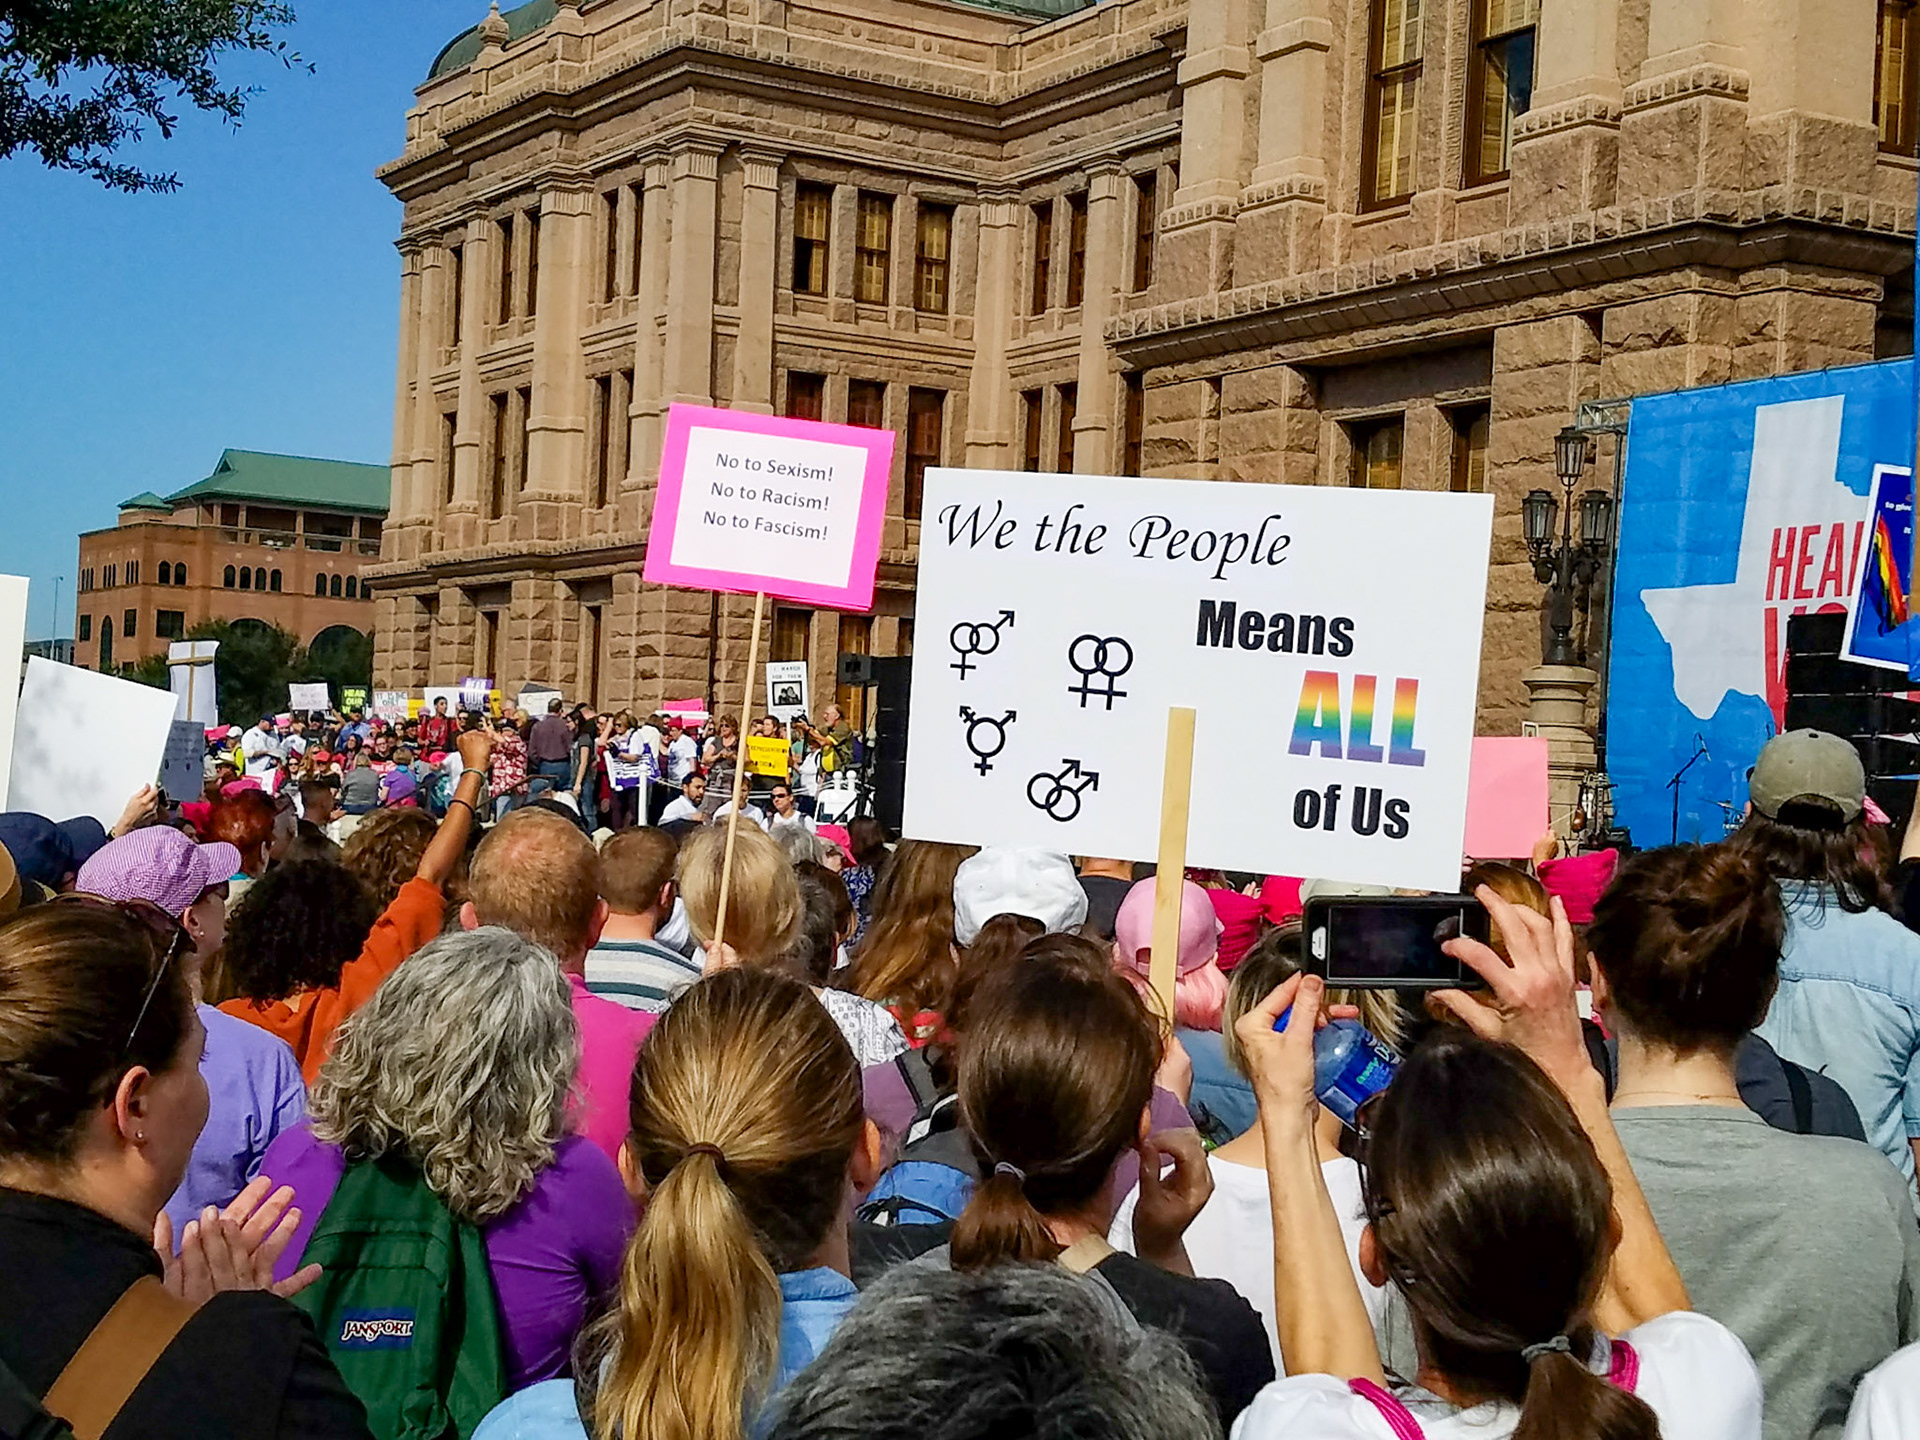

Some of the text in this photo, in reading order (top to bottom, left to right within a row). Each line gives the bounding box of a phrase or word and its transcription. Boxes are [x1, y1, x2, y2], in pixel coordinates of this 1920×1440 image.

[715, 453, 834, 482] No to Sexism!
[710, 481, 830, 511] No to Racism!
[702, 510, 828, 541] No to Fascism!
[938, 499, 1291, 581] We the People
[1196, 599, 1355, 658] Means
[1287, 670, 1426, 767] ALL
[1293, 784, 1410, 840] of Us
[341, 1319, 414, 1342] JANSPORT
